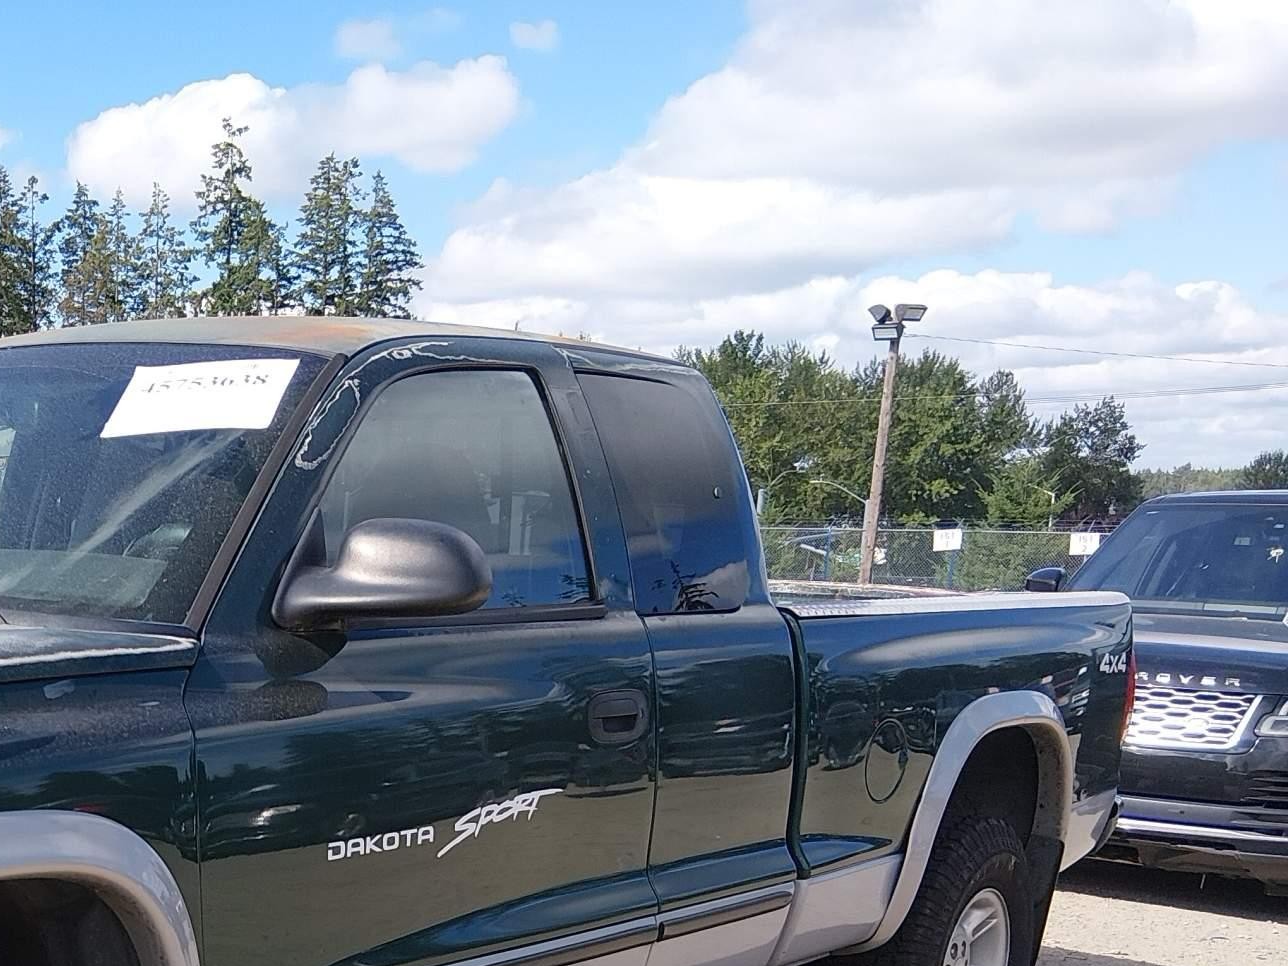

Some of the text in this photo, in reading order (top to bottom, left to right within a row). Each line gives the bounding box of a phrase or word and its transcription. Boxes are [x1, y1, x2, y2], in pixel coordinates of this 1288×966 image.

[1134, 672, 1241, 686] ROVER
[328, 789, 563, 861] DAKOTA SPORT
